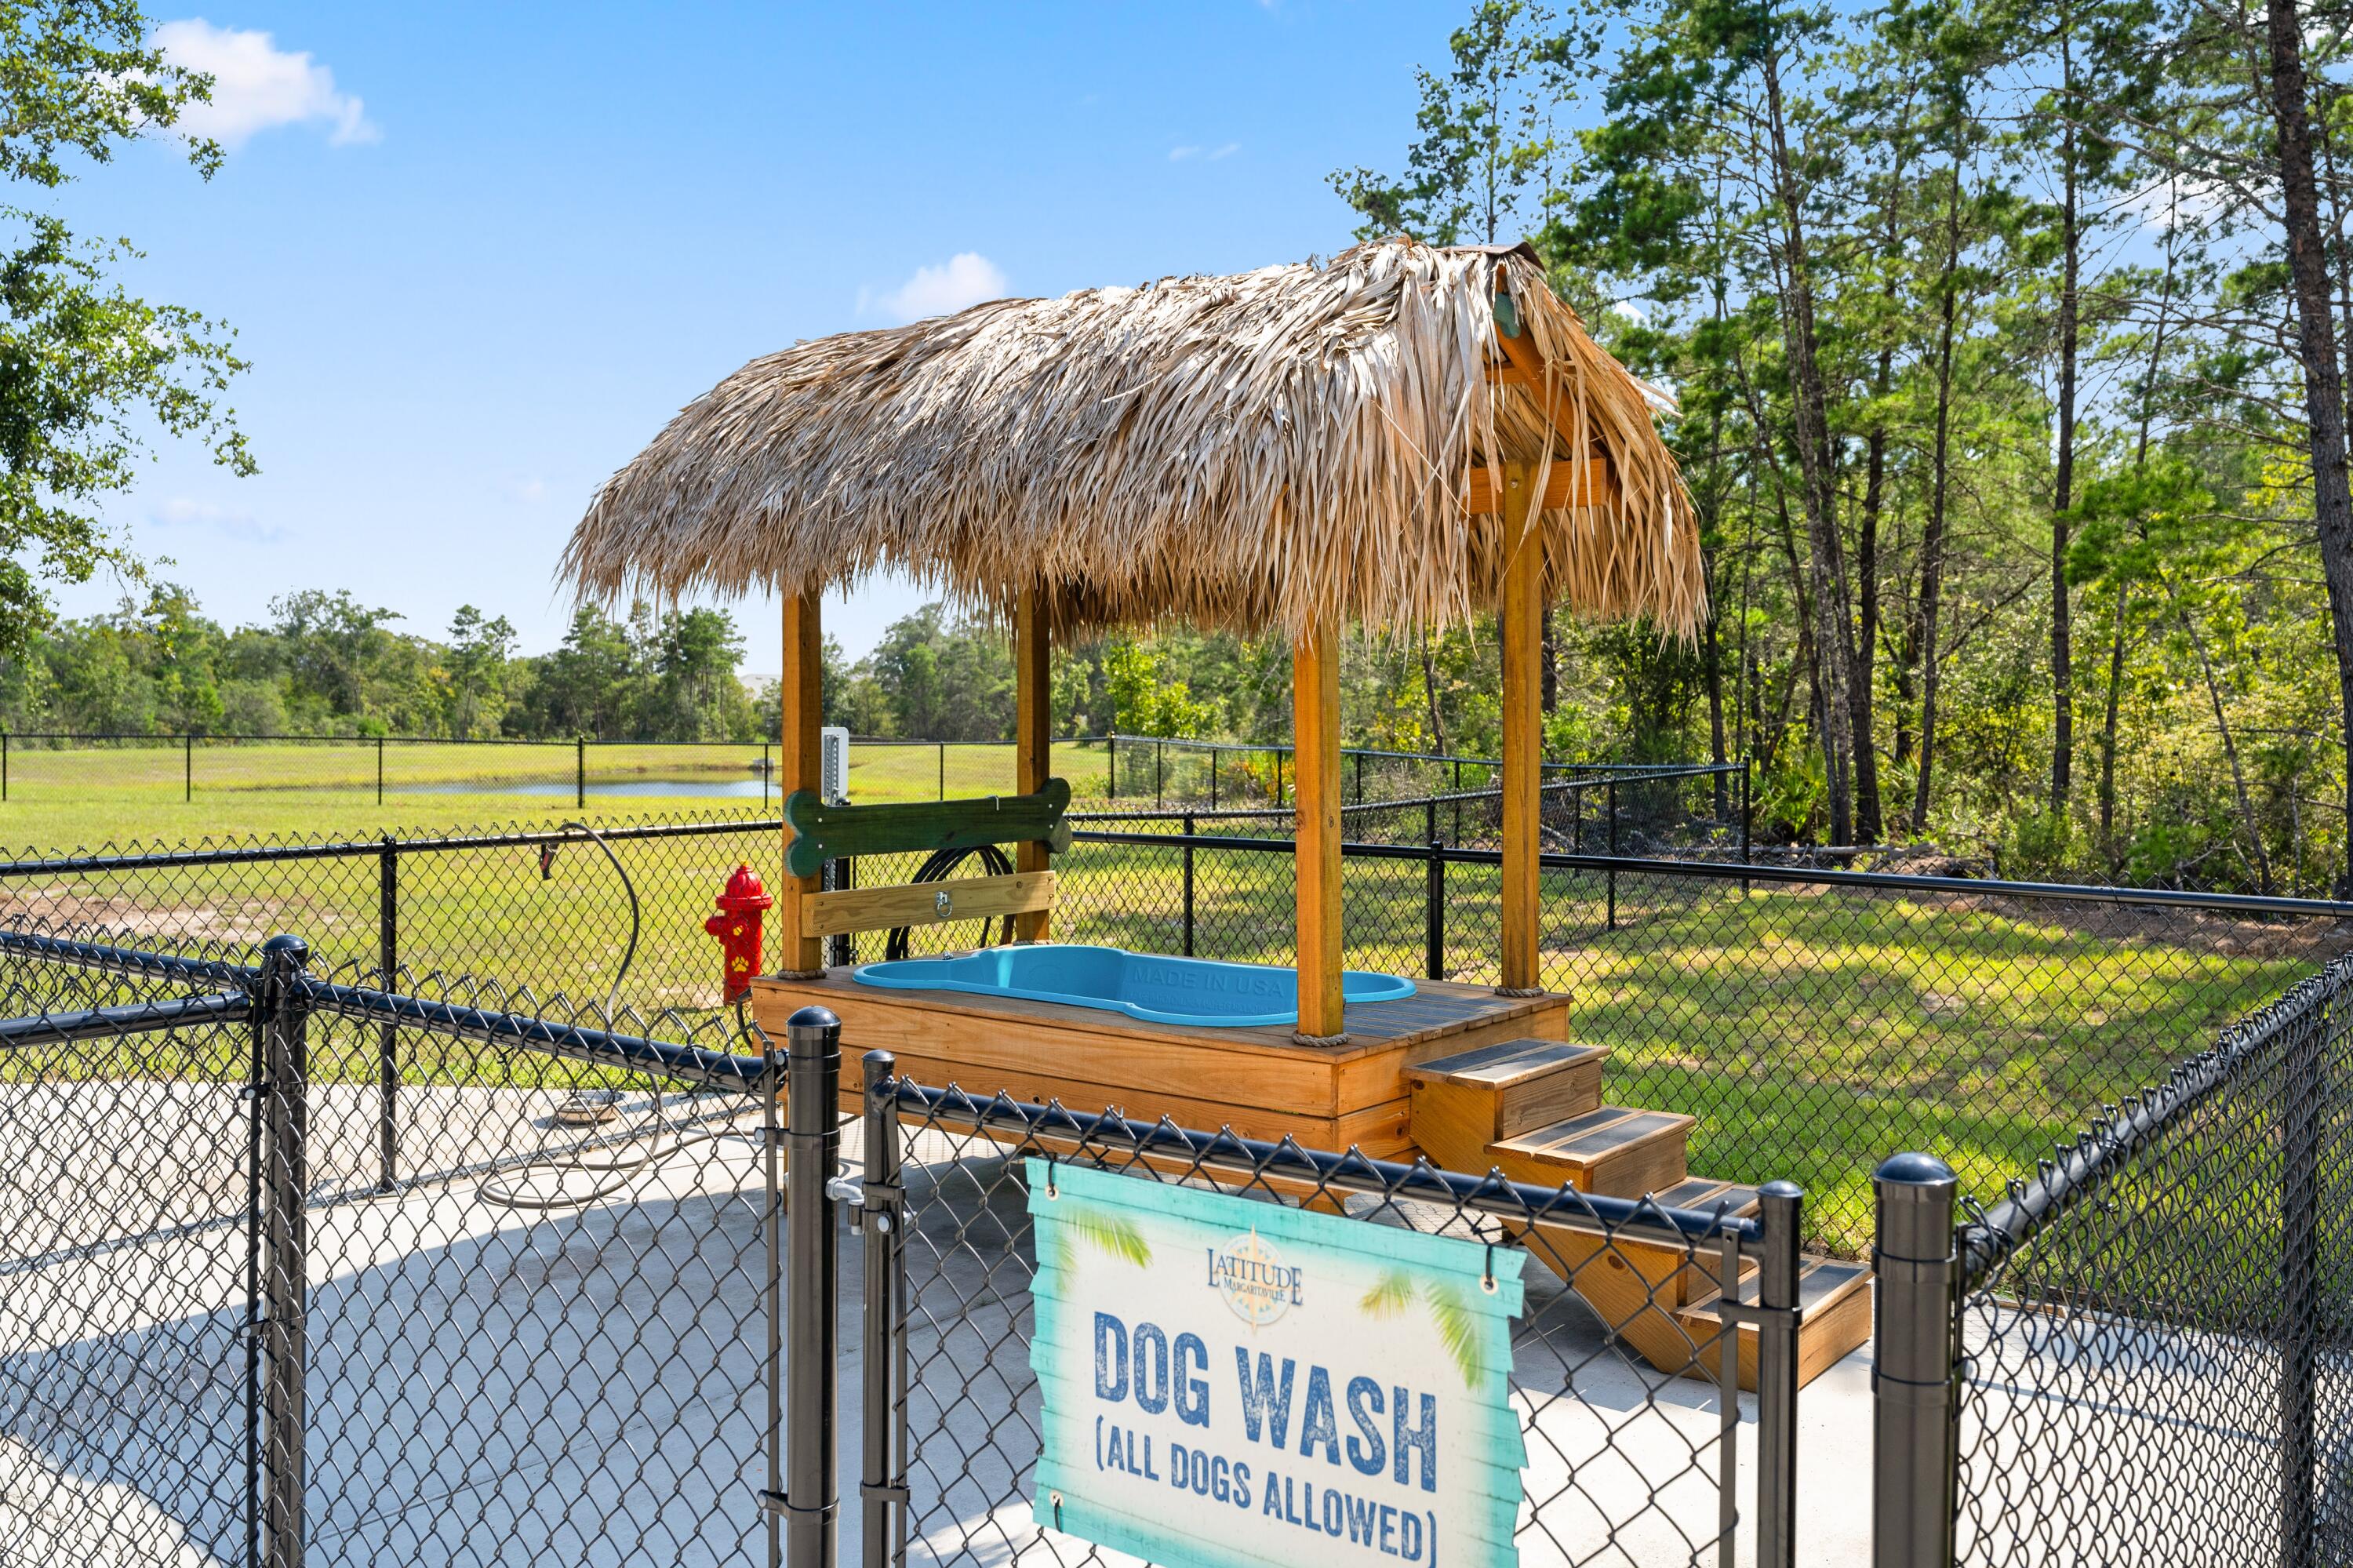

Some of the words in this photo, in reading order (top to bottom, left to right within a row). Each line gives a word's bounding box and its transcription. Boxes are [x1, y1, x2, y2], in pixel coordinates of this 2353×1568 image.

[1134, 966, 1198, 989] MADE
[1204, 972, 1228, 992] IN
[1236, 976, 1286, 999] USA
[1207, 1248, 1304, 1306] LATITUDE
[1224, 1276, 1286, 1302] MARGARITAVILLE
[1093, 1311, 1209, 1428] DOG
[1235, 1345, 1436, 1493] WASH
[1096, 1413, 1159, 1483] (ALL
[1170, 1442, 1252, 1509] DOGS
[1263, 1472, 1437, 1568] ALLOWED)
